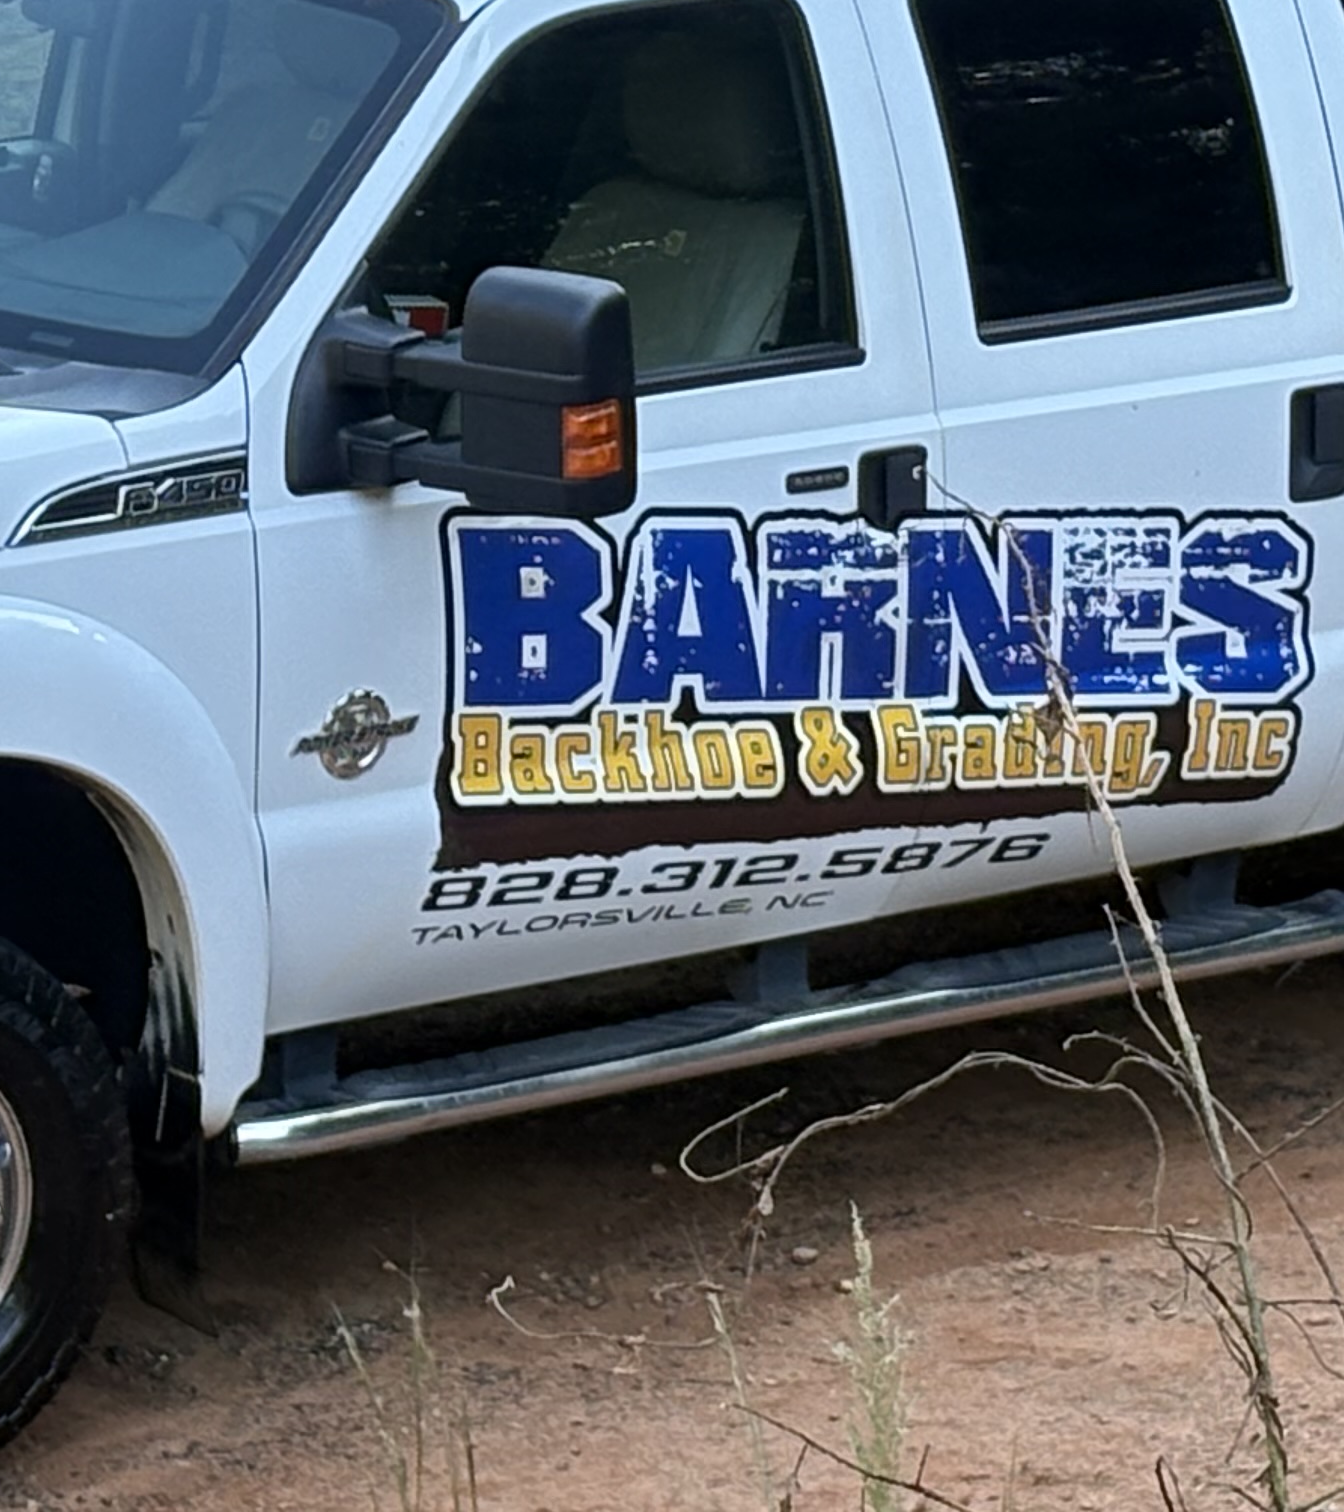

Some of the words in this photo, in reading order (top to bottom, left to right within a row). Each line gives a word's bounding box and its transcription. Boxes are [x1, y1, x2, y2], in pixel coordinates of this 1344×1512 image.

[446, 518, 1306, 714] BARNES
[456, 707, 780, 797] Backhoe
[800, 705, 857, 789] &
[875, 700, 1164, 793] Grading,
[1188, 699, 1292, 776] Inc
[421, 833, 1052, 914] 828.312.5876
[764, 889, 837, 911] NC
